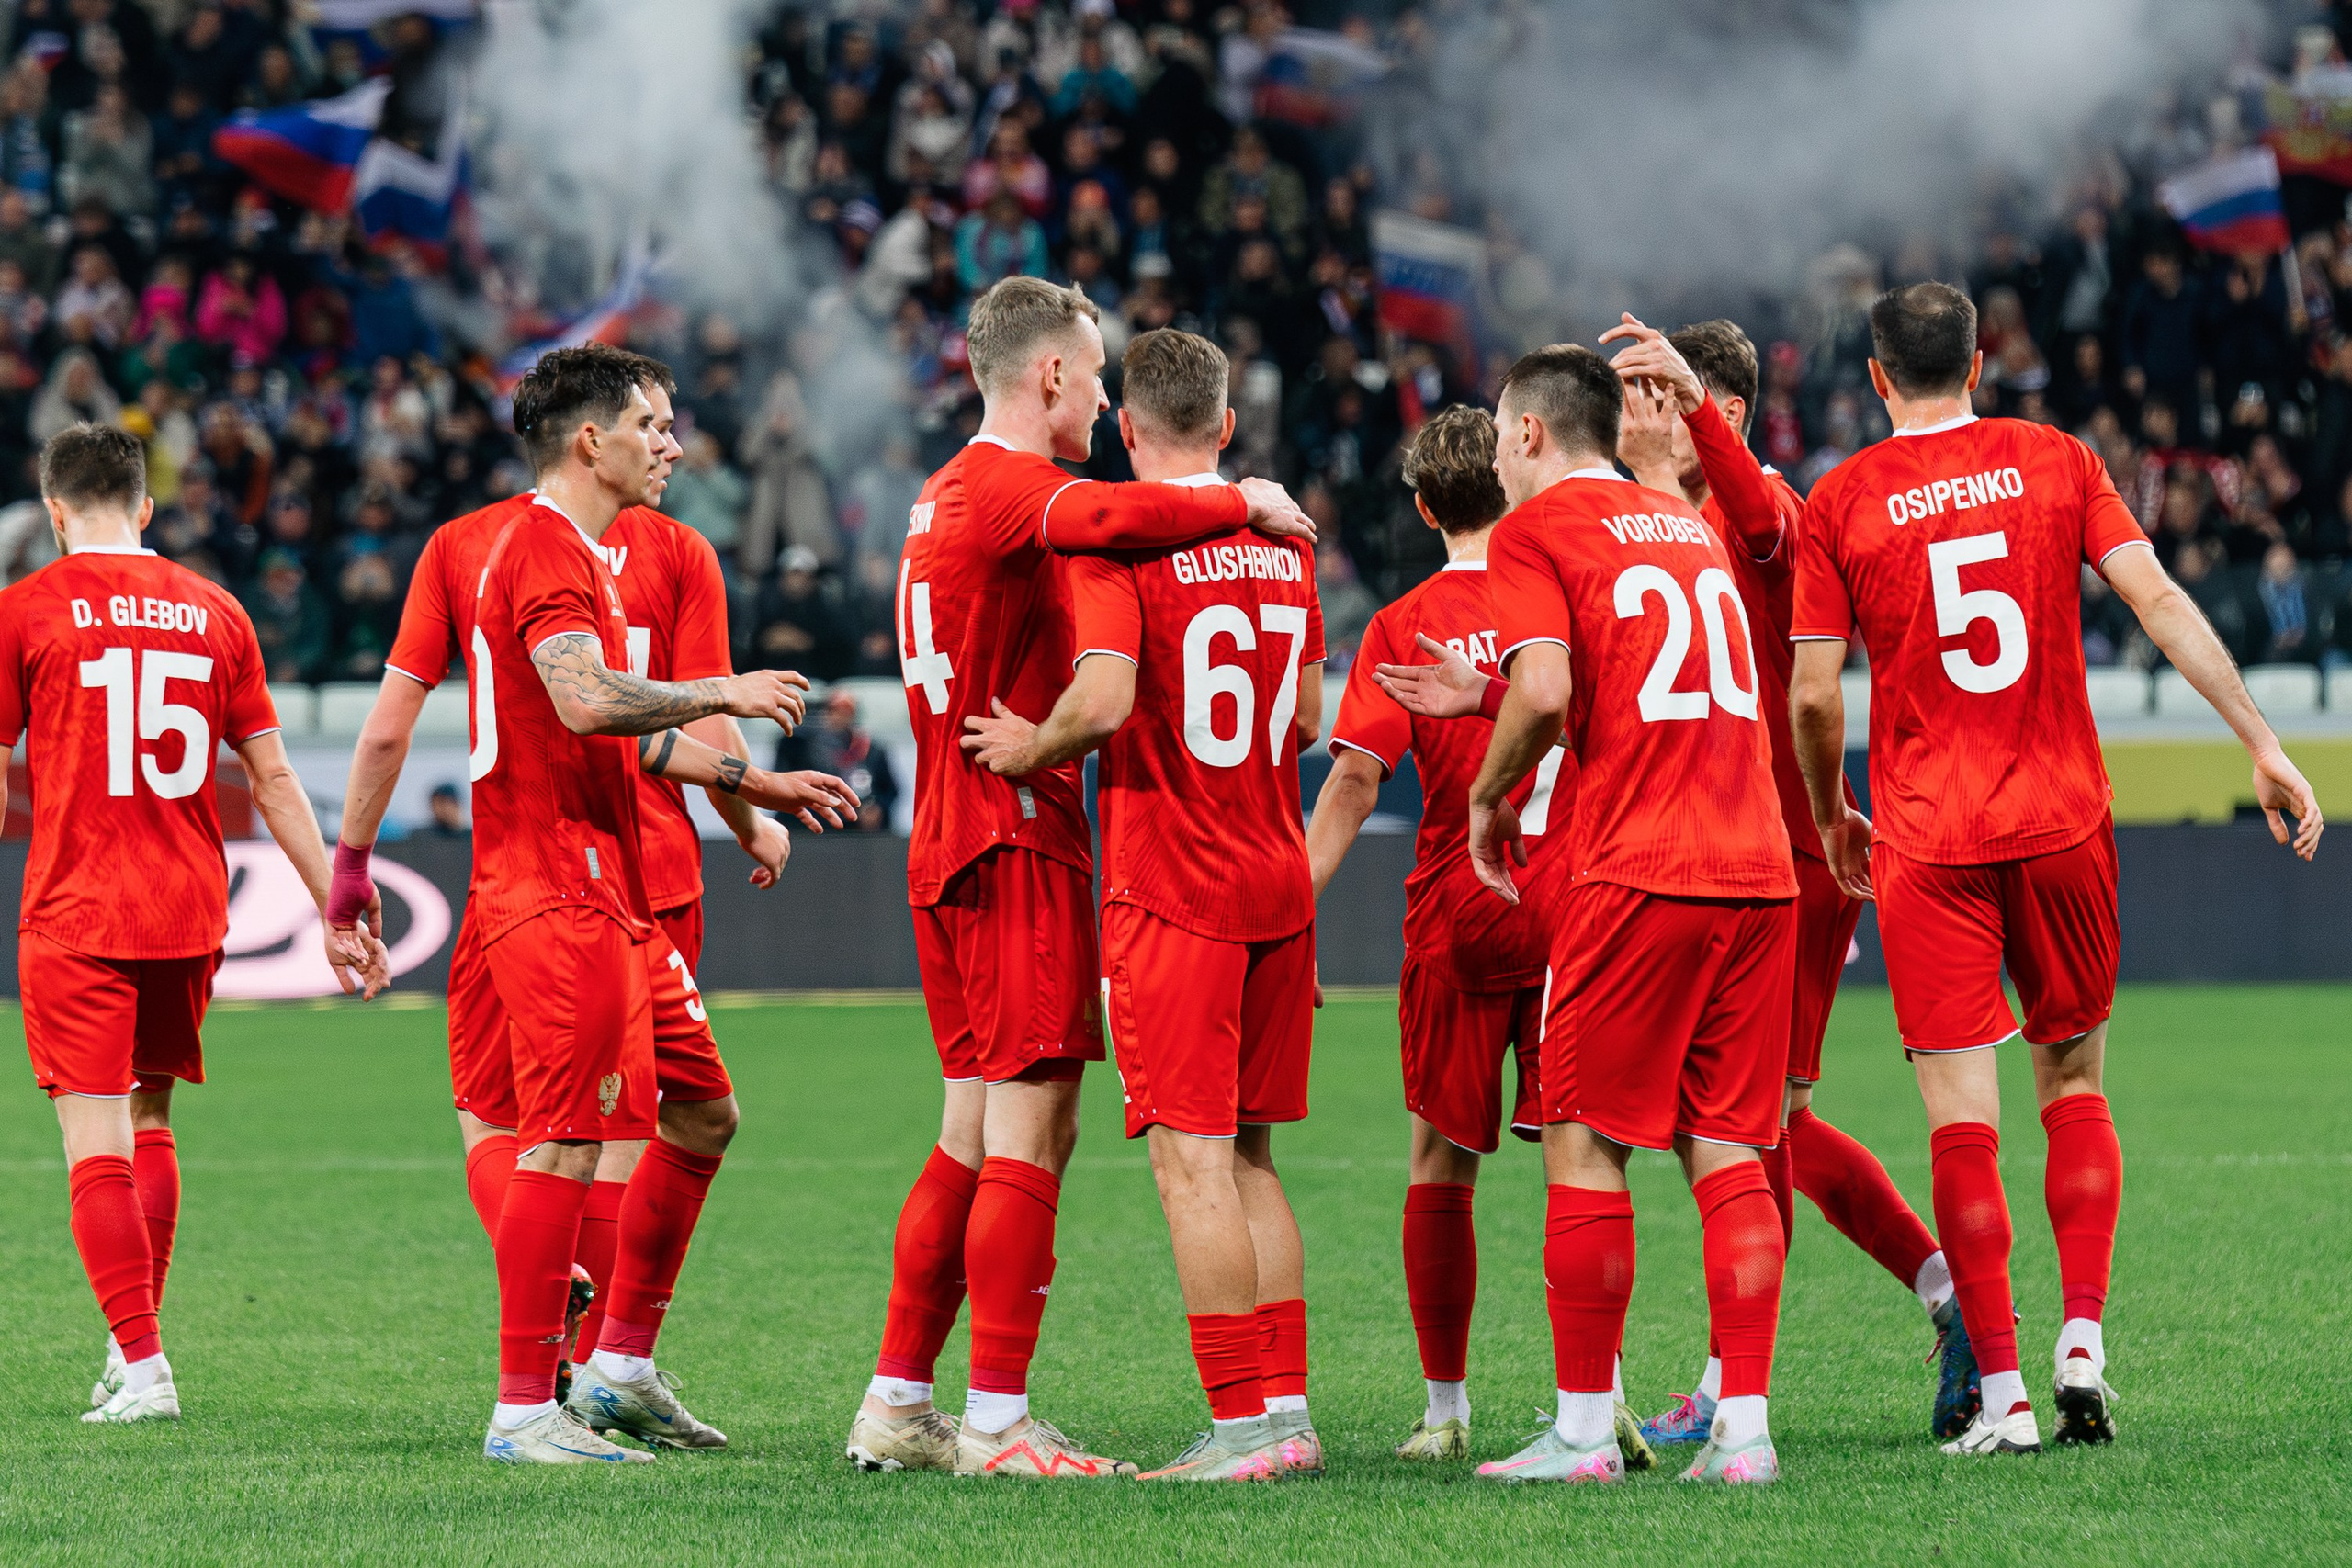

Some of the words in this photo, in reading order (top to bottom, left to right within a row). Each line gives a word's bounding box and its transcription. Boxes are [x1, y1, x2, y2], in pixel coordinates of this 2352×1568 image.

[1887, 467, 2024, 525] OSIPENKO
[1600, 512, 1711, 547] VOROBEV
[1171, 544, 1302, 585] GLUSHENKOV
[71, 598, 103, 629] D.
[109, 594, 208, 636] GLEBOV
[1928, 530, 2029, 694] 5
[1445, 630, 1499, 667] BAT
[1613, 564, 1759, 723] 20
[1182, 604, 1308, 768] 67
[79, 647, 214, 800] 15
